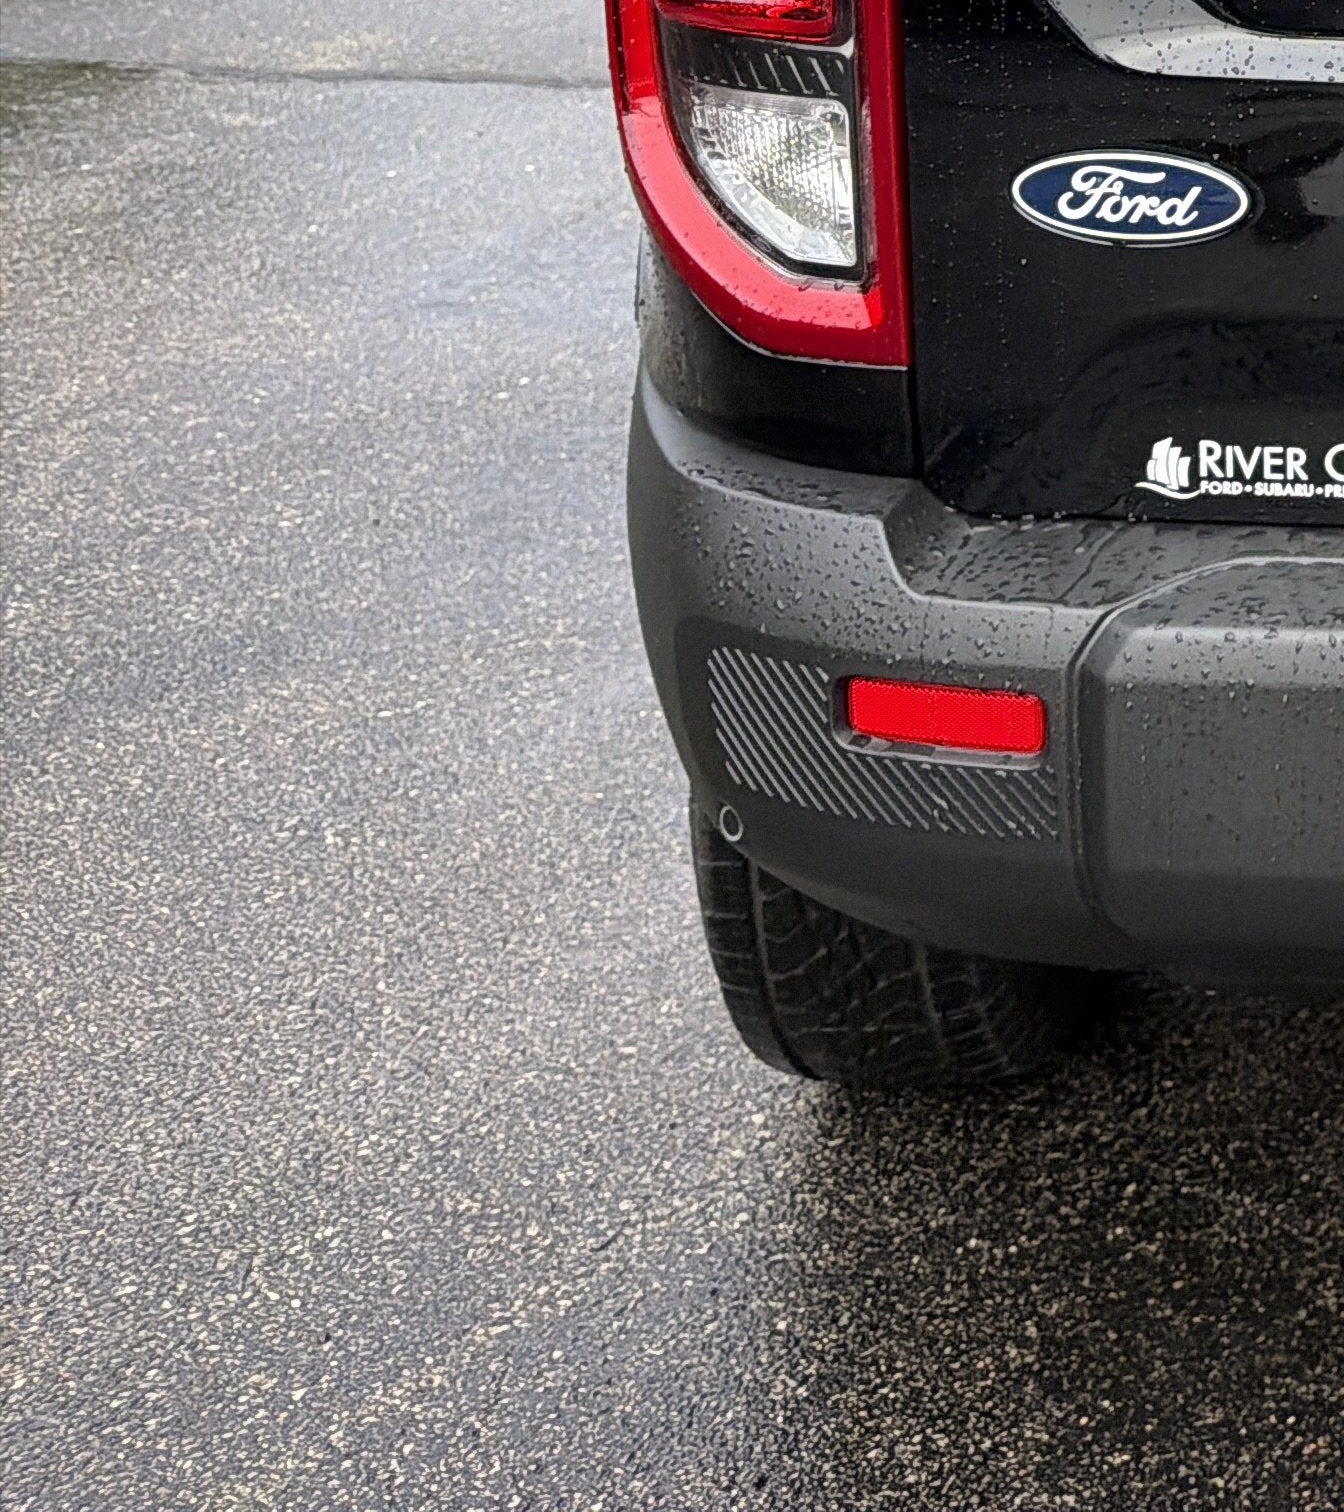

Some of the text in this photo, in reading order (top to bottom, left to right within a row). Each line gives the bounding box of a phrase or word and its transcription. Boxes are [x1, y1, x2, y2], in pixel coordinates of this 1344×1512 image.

[1056, 163, 1203, 226] Ford
[1198, 439, 1309, 481] RIVER
[1200, 480, 1243, 496] FORD
[1253, 481, 1315, 498] SUBARU
